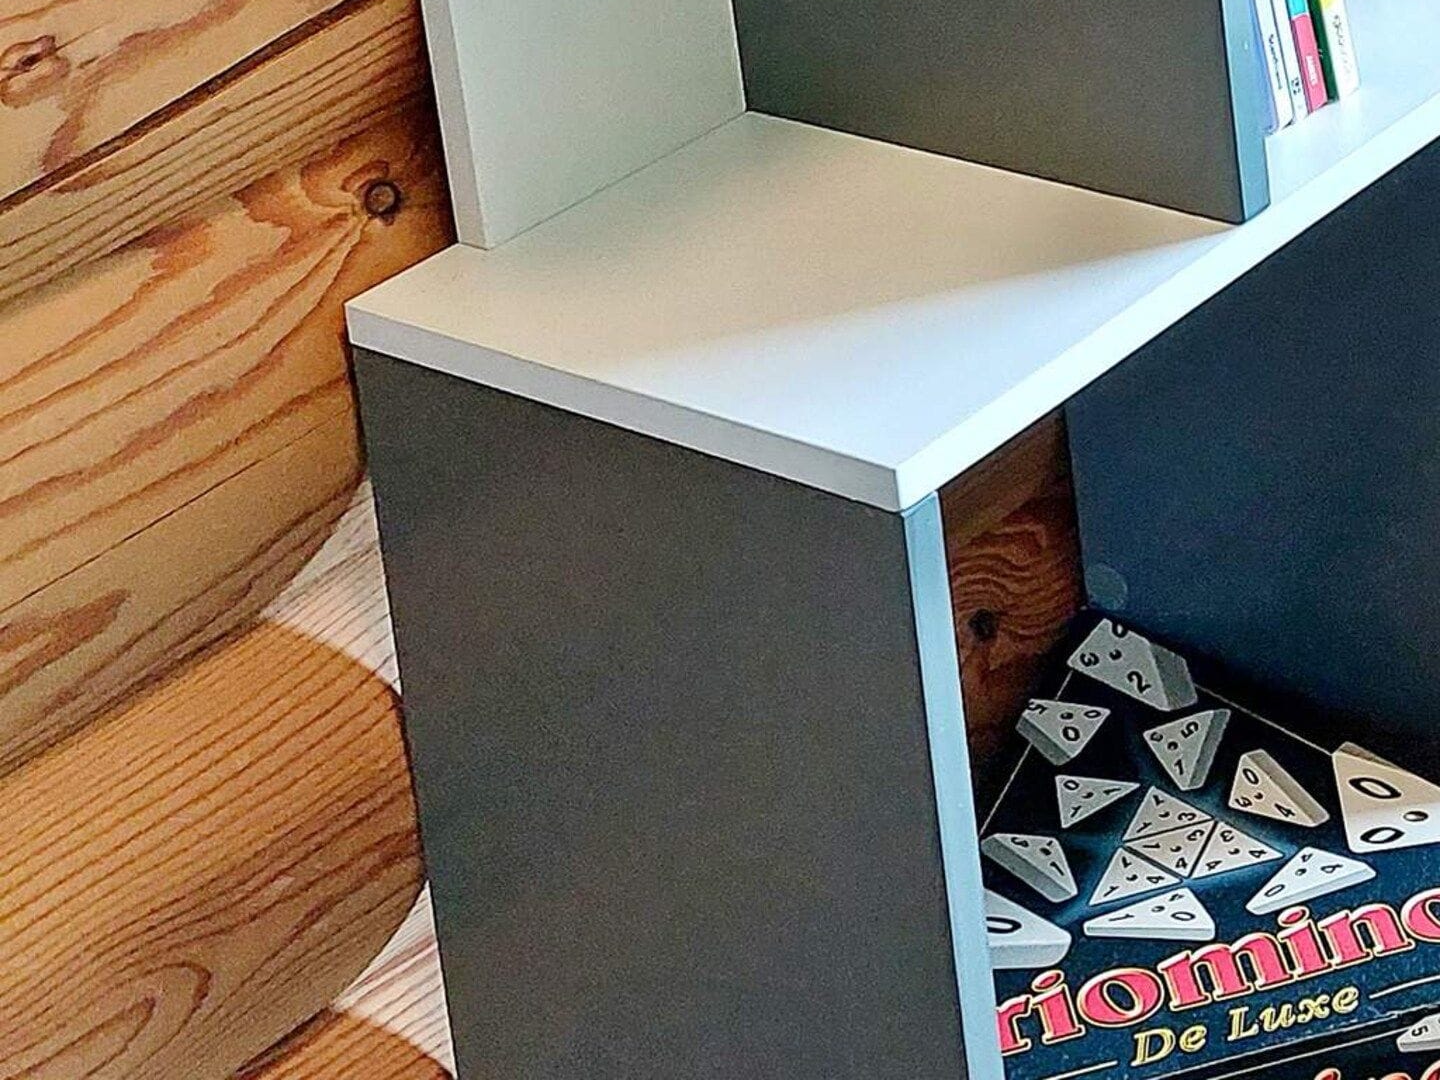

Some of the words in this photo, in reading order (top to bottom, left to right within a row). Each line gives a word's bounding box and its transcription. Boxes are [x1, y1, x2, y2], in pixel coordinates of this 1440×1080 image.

[1127, 671, 1151, 693] 2
[1130, 1024, 1208, 1067] De
[1227, 985, 1360, 1041] Luxe
